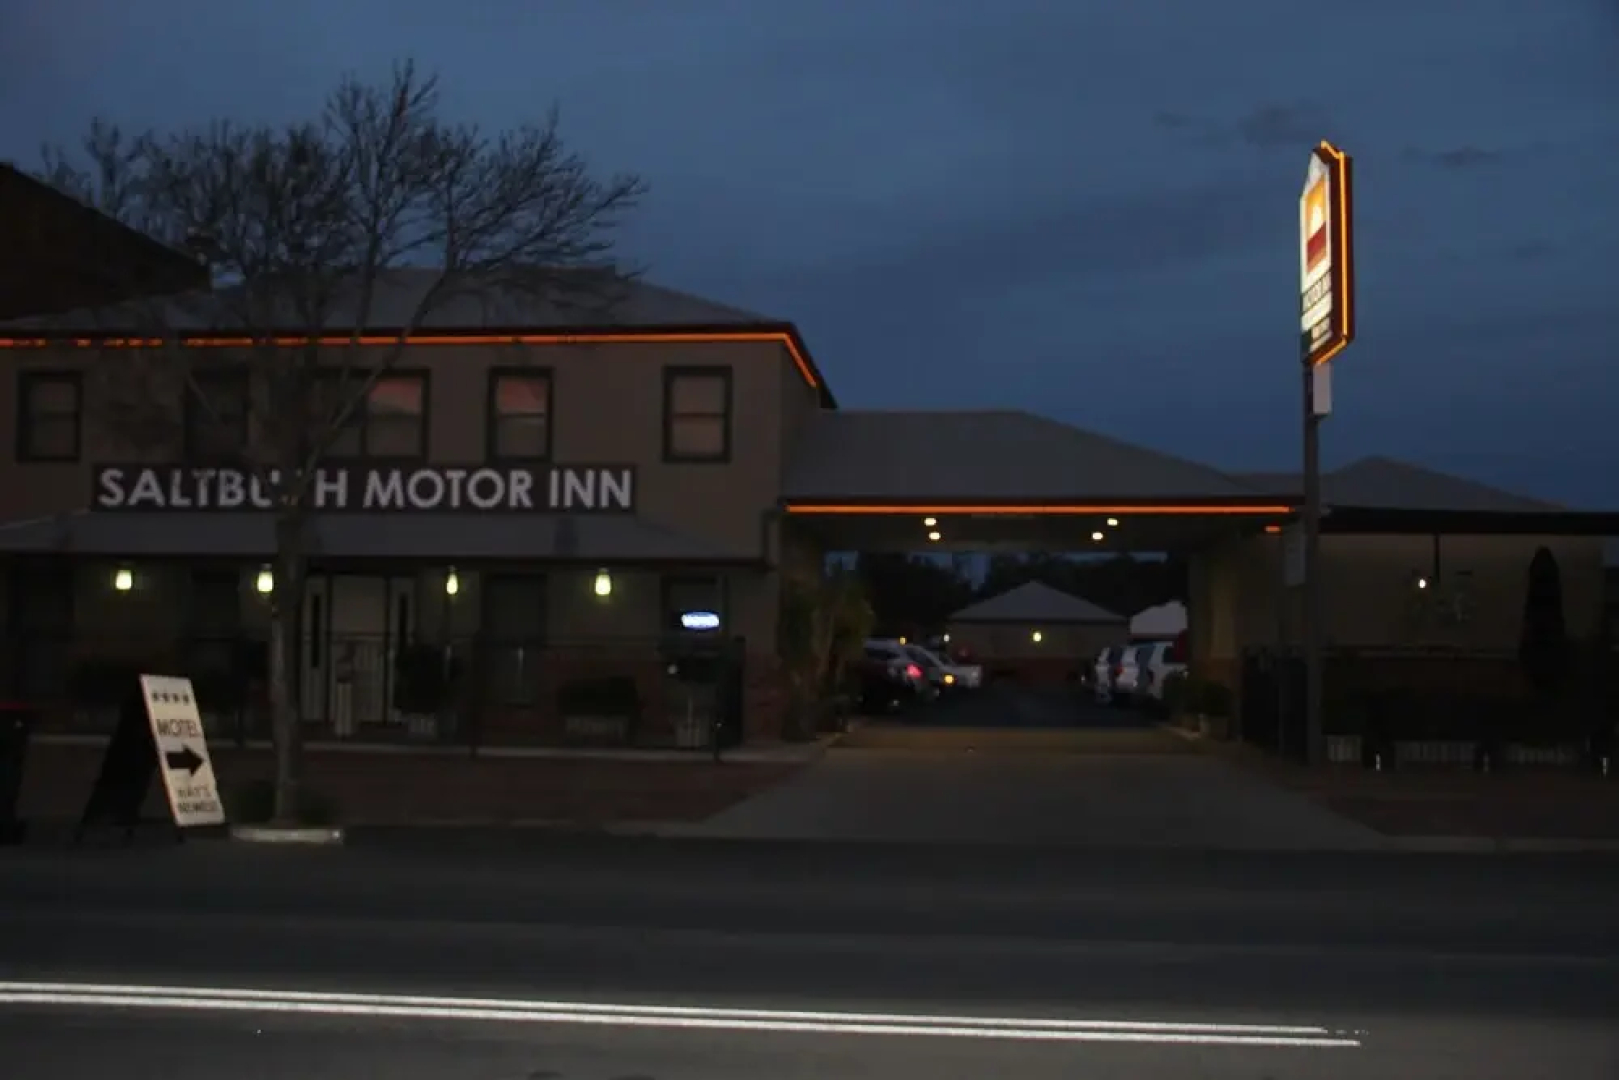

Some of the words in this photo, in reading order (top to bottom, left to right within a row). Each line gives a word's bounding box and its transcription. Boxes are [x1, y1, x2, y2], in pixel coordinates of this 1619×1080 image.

[99, 467, 348, 508] SALTBUH
[362, 468, 533, 509] MOTOR
[549, 468, 631, 508] INN
[155, 718, 201, 738] MOTEL
